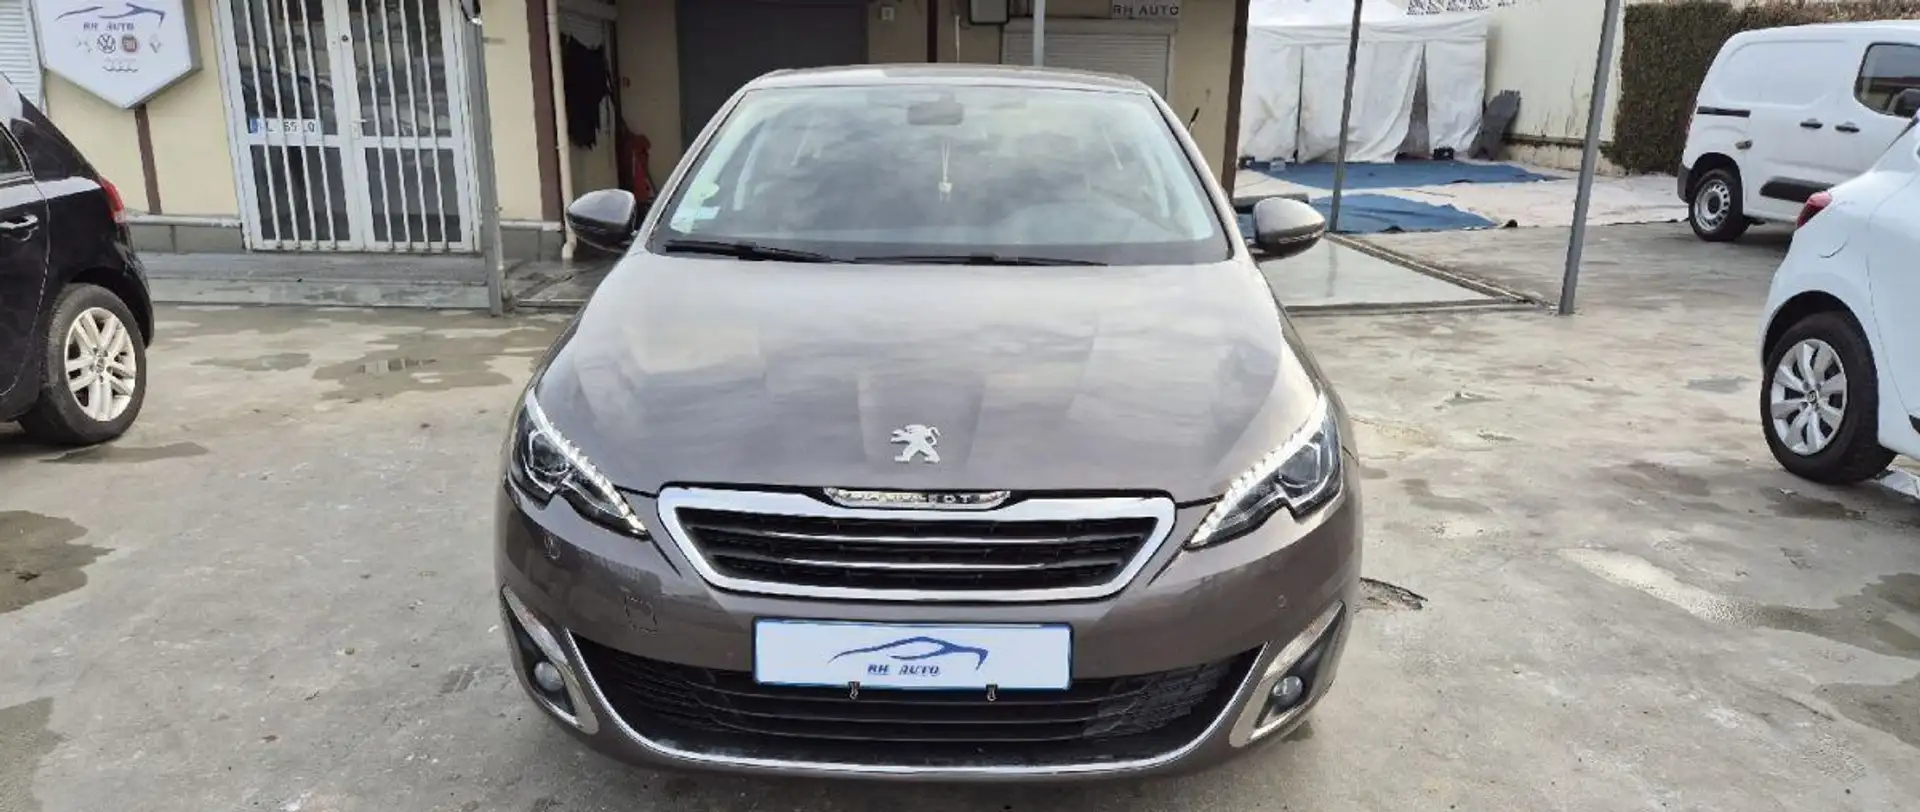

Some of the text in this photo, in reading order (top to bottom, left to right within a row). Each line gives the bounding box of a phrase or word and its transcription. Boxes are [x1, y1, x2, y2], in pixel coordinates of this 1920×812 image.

[1113, 5, 1179, 16] RH AUTO
[106, 21, 135, 31] AUTO
[867, 664, 941, 677] RH AUTO
